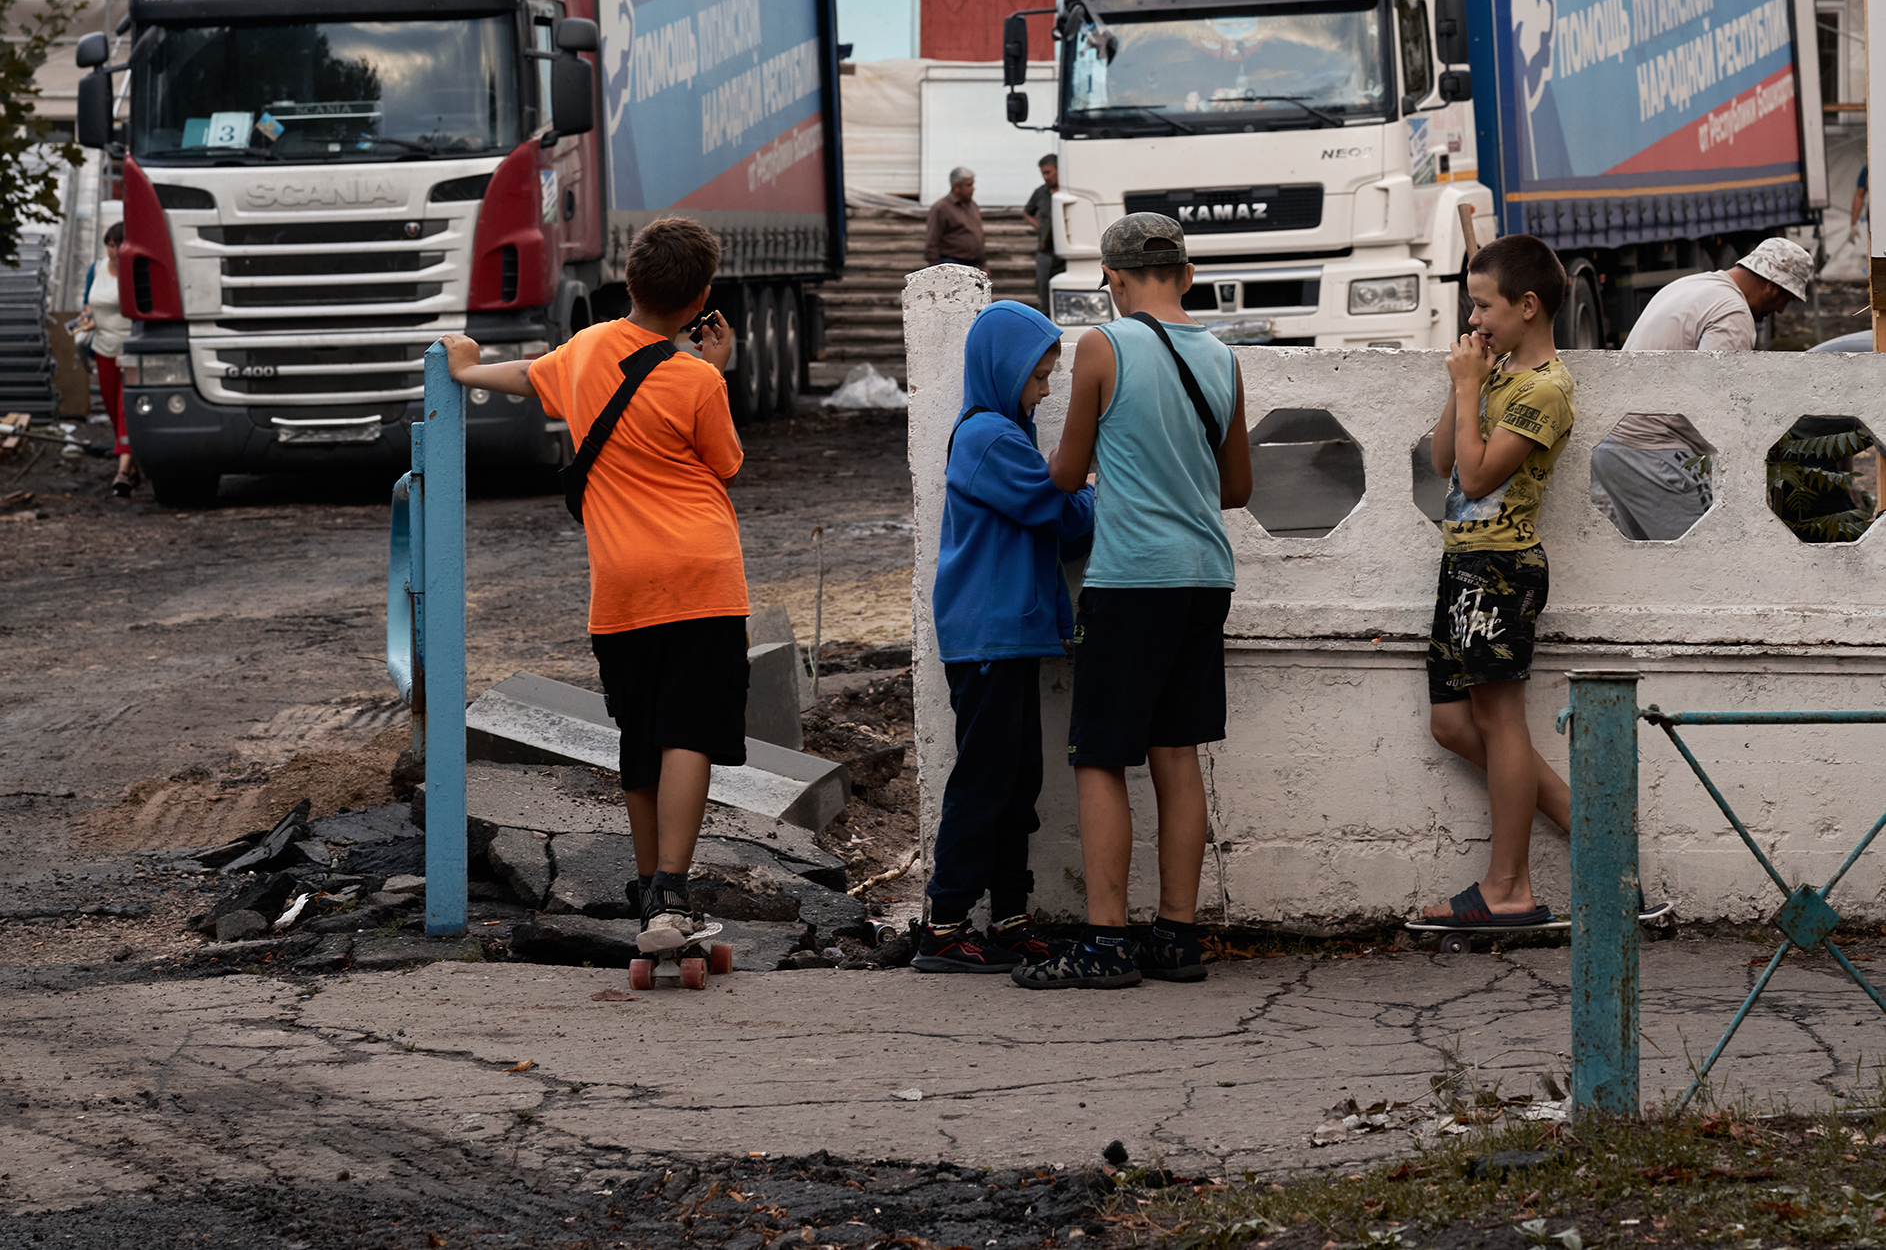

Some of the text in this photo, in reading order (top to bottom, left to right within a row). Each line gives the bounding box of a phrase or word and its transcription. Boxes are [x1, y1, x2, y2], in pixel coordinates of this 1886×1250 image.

[635, 16, 697, 103] ПОМОЩЬ
[1636, 17, 1716, 122] НАРОДНОЙ
[702, 51, 763, 155] НАРОДНОЙ
[219, 125, 235, 142] 3
[247, 179, 398, 209] SCANIA
[1178, 202, 1268, 222] KAMAZ
[241, 365, 275, 378] 400
